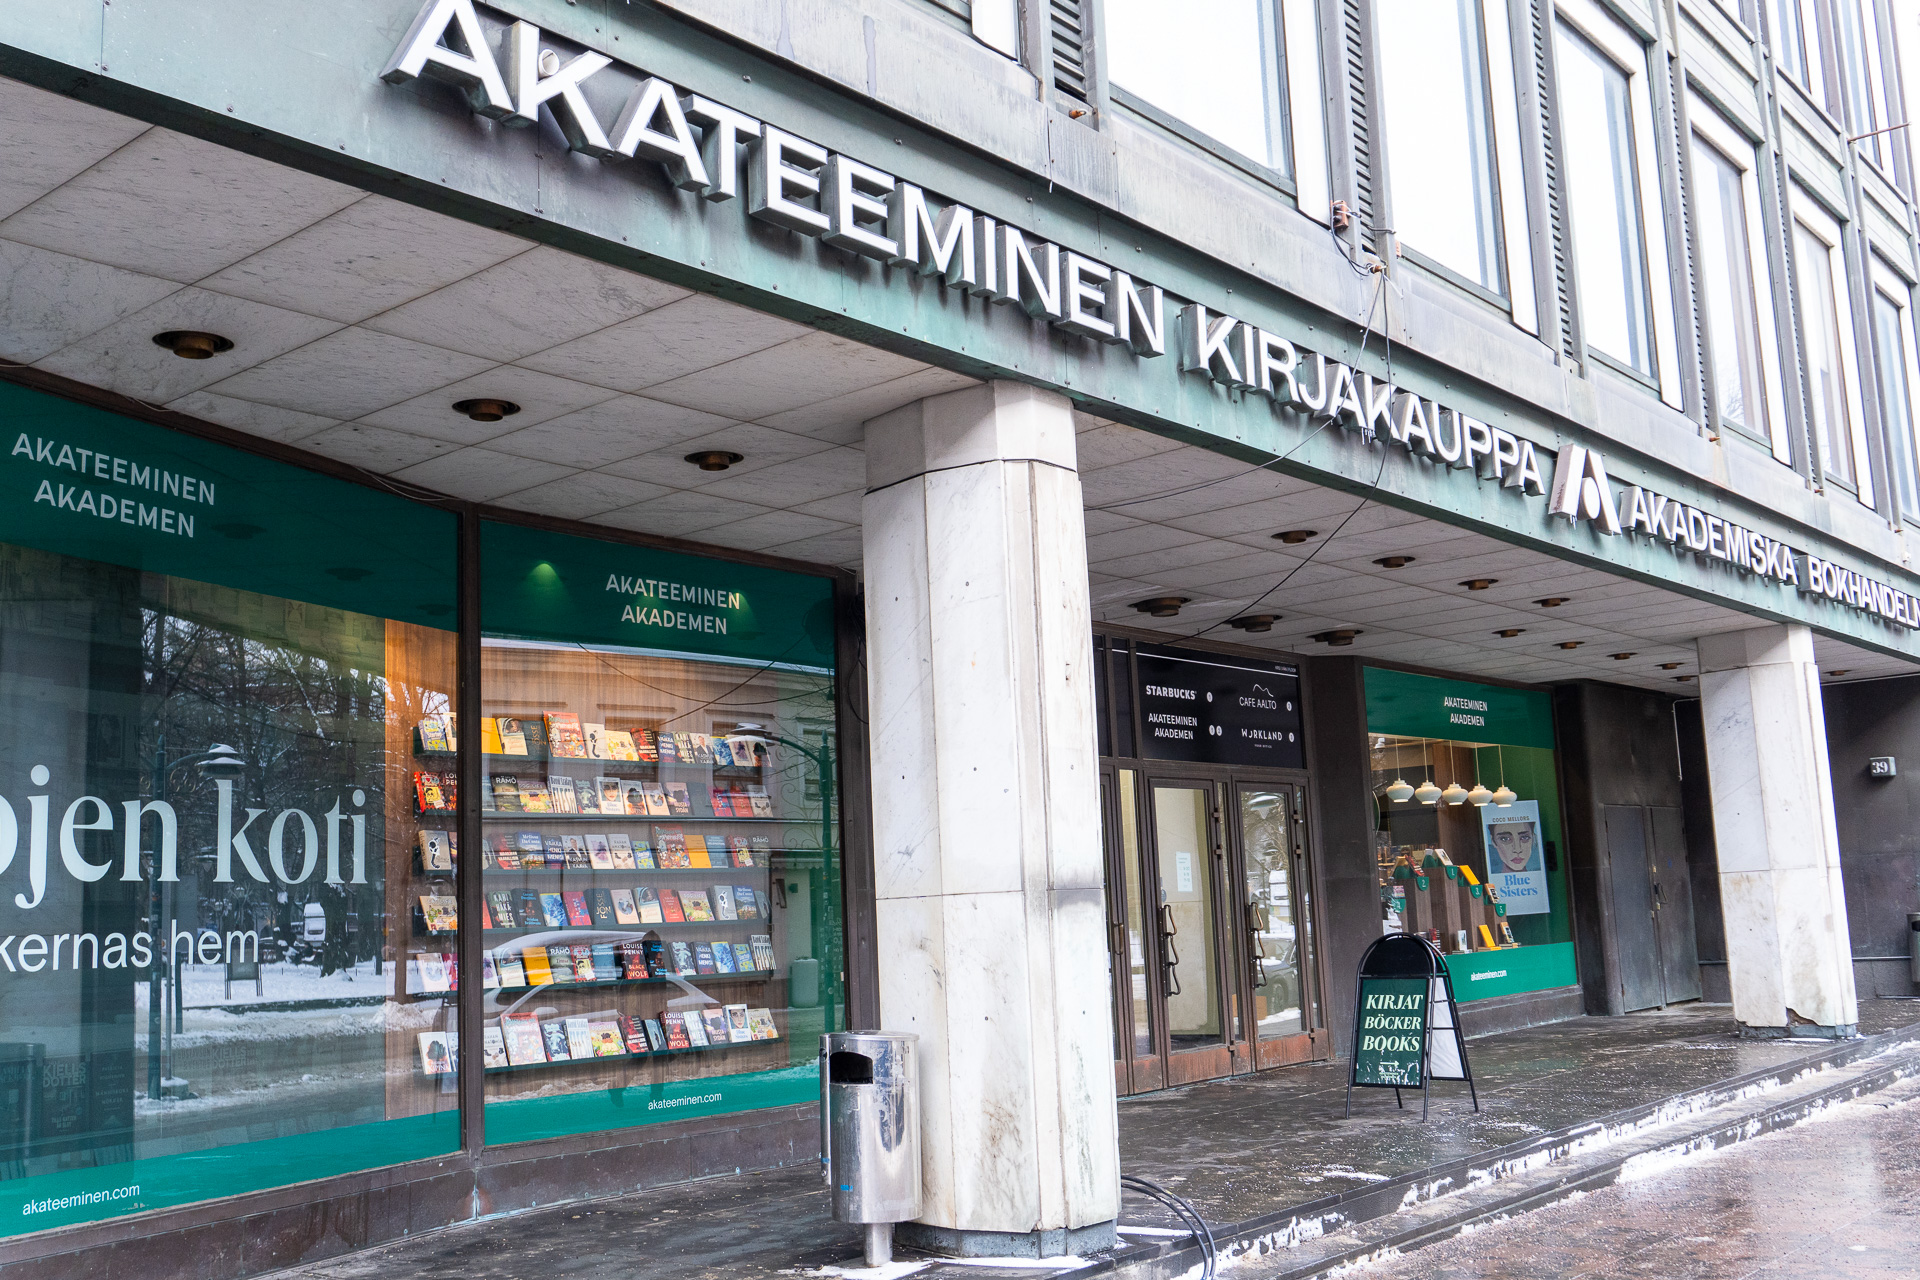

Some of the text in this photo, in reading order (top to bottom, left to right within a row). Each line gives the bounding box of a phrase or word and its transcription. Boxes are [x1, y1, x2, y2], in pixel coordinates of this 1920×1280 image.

[381, 0, 1165, 356] AKATEEMINEN
[1194, 303, 1545, 496] KIRJAKAUPPA
[11, 432, 215, 506] AKATEEMINEN
[33, 479, 194, 538] AKADEMEN
[1628, 485, 1799, 585] AKADEMISKA
[605, 573, 740, 610] AKATEEMINEN
[620, 604, 727, 635] AKADEMEN
[1239, 696, 1256, 708] CAFE
[1257, 699, 1277, 710] AALTO
[1443, 696, 1488, 712] AKATEEMINEN
[1148, 712, 1198, 727] AKATEEMINEN
[1450, 713, 1485, 727] AKADEMEN
[1154, 727, 1194, 740] AKADEMEN
[1872, 761, 1889, 774] 39
[0, 764, 368, 909] jen koti
[1504, 874, 1531, 887] Blue
[1500, 886, 1538, 898] Sisters
[171, 919, 259, 966] hem
[1365, 994, 1424, 1010] KIRJAT
[1364, 1013, 1422, 1030] BÖCKER
[1362, 1035, 1420, 1052] BOOKS
[647, 1093, 722, 1111] akateeminen.com
[22, 1185, 140, 1216] akateeminen.com
